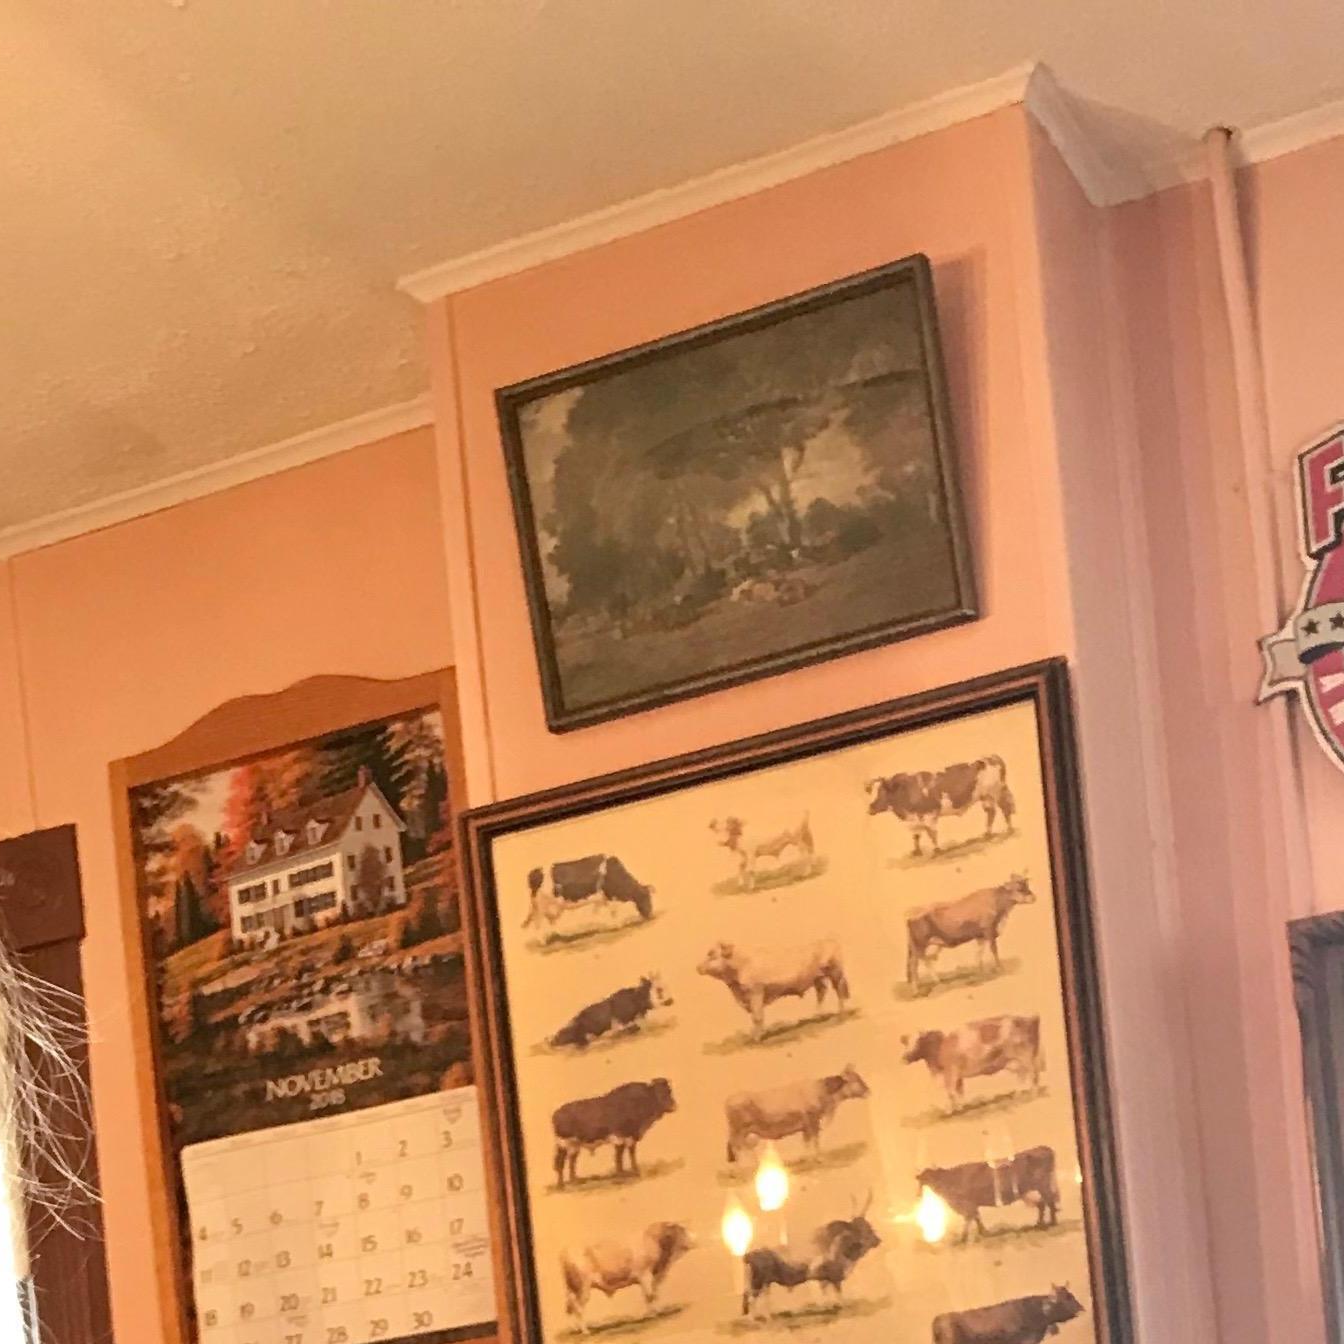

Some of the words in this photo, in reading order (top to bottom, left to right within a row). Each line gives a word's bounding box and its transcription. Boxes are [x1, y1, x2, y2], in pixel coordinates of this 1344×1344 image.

[265, 1056, 384, 1102] NOVEMBER
[355, 1150, 362, 1165] 1
[399, 1140, 407, 1157] 2
[442, 1131, 452, 1148] 3
[199, 1226, 208, 1241] 4
[231, 1217, 243, 1235] 5
[269, 1210, 283, 1226] 6
[314, 1200, 324, 1217] 7
[358, 1192, 370, 1210] 8
[400, 1184, 413, 1198] 9
[446, 1173, 464, 1191] 10
[275, 1251, 291, 1268] 13
[318, 1242, 333, 1259] 14
[361, 1235, 378, 1252] 15
[406, 1229, 421, 1244] 16
[449, 1217, 464, 1235] 17
[279, 1293, 300, 1312] 20
[321, 1287, 338, 1305] 21
[363, 1278, 383, 1298] 22
[408, 1269, 429, 1288] 23
[452, 1262, 473, 1281] 24
[326, 1325, 349, 1344] 28
[369, 1318, 389, 1338] 29
[411, 1309, 433, 1330] 30
